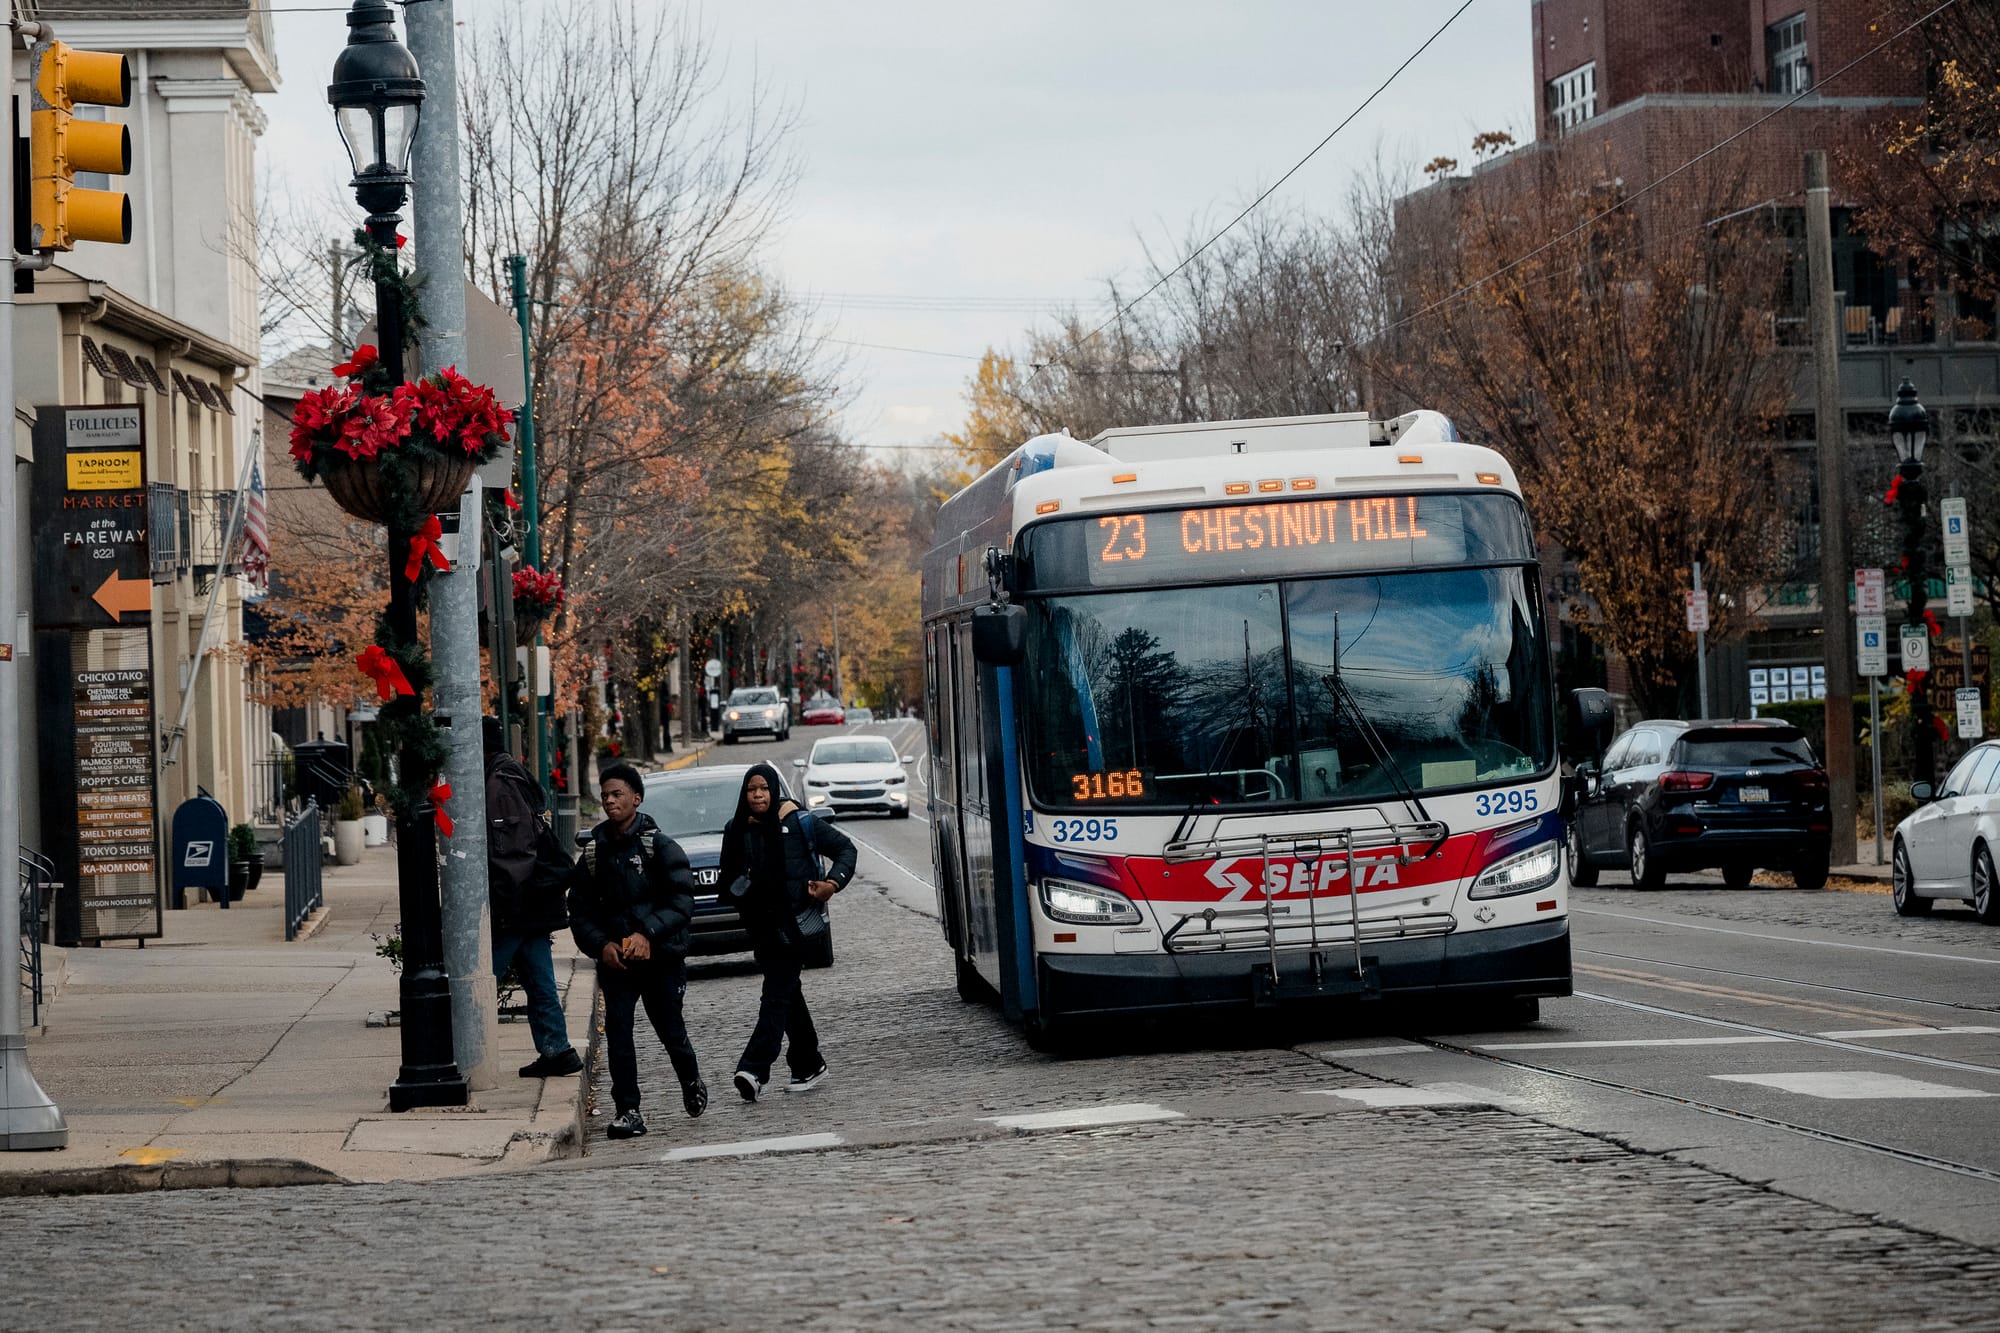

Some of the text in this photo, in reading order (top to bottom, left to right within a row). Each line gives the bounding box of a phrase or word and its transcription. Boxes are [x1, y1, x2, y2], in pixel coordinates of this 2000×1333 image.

[69, 417, 137, 431] FOLLICLES
[1231, 442, 1246, 453] T
[77, 459, 130, 467] TAPROOM
[101, 519, 116, 528] the
[1099, 496, 1428, 562] 23 CHESTNUT HILL
[63, 529, 146, 545] FAREWAY
[92, 548, 115, 559] 8221
[1911, 641, 1918, 654] P
[78, 671, 143, 682] CHICKO TAKO
[1936, 668, 1961, 687] Cat
[94, 708, 126, 716] BORSCHT
[81, 758, 112, 766] MOMOS
[113, 757, 123, 765] OF
[81, 775, 146, 786] POPPY'S CAFE
[1072, 770, 1143, 800] 3166
[100, 795, 119, 803] FINE
[119, 793, 146, 802] MEATS
[1475, 788, 1538, 817] 3295
[86, 811, 143, 820] LIBERTY KITCHEN
[80, 828, 150, 838] SMELL THE CURRY
[1053, 818, 1118, 842] 3295
[84, 845, 150, 856] TOKYO SUSHI
[83, 863, 149, 874] KA-NOM NOM
[1259, 855, 1399, 896] SEPTA
[110, 898, 137, 906] NOODLE
